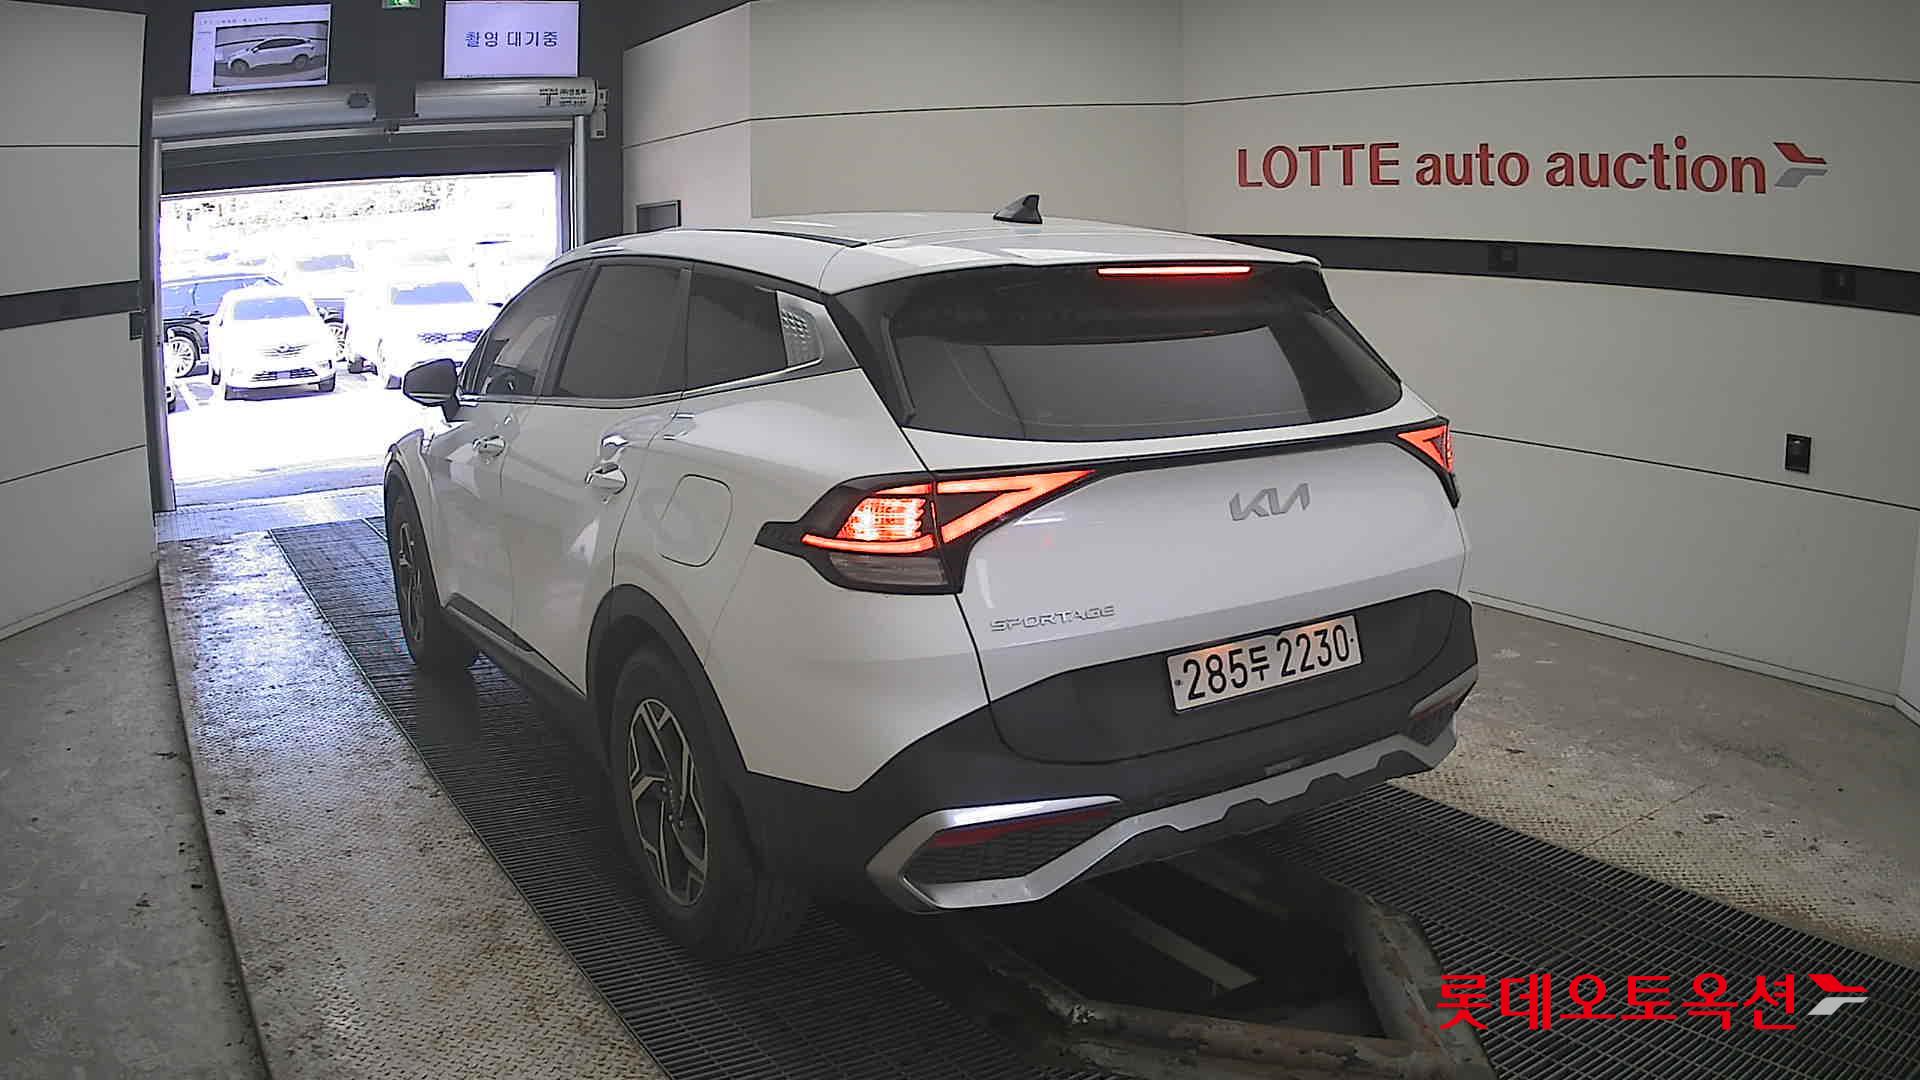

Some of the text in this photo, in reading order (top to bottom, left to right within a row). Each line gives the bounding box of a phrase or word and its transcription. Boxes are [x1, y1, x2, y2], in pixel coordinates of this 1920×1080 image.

[465, 31, 560, 48] 촬영 대기중
[1237, 137, 1766, 194] LOTTE auto auction
[991, 606, 1116, 633] SPORTAGE
